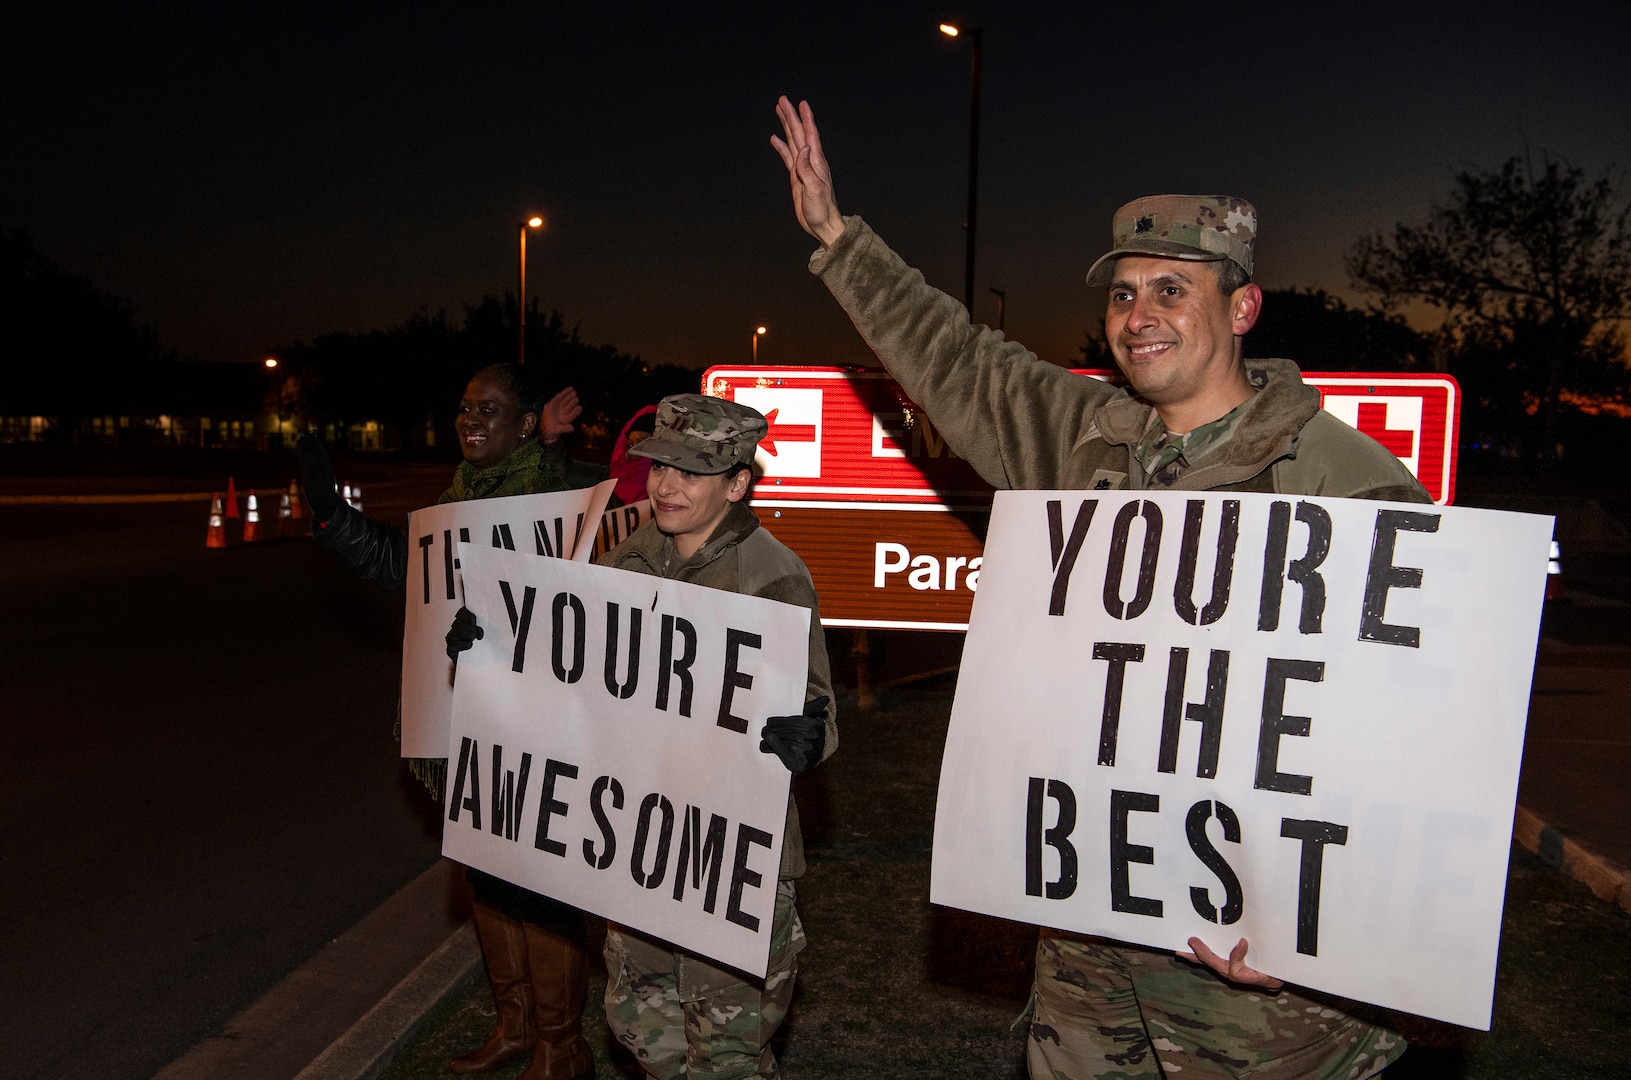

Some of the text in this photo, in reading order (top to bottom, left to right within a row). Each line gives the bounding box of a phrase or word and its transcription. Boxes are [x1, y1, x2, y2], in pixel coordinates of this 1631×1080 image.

[419, 512, 585, 604] THN
[1046, 499, 1442, 648] YOURE
[499, 580, 763, 735] YOU'RE
[1091, 642, 1326, 796] THE
[448, 737, 774, 932] AWESOME
[1025, 777, 1349, 957] BEST
